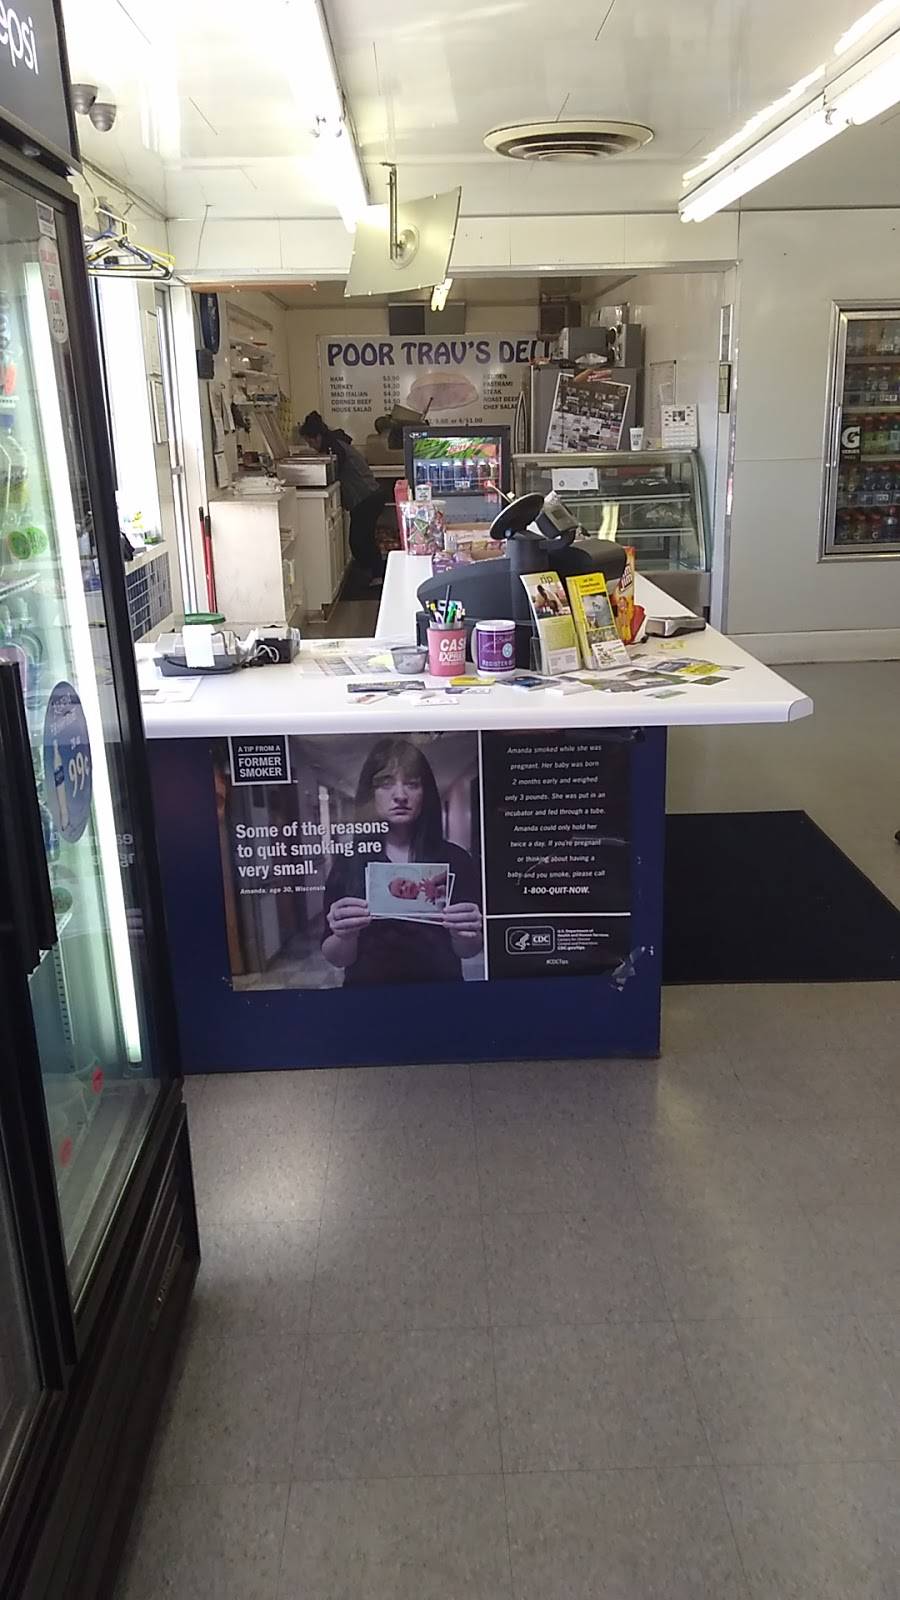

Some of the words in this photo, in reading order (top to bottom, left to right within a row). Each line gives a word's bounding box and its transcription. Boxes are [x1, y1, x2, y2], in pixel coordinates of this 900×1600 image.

[327, 342, 395, 367] POOR
[400, 341, 491, 365] TRAV'S
[841, 426, 861, 448] G
[238, 756, 282, 767] FORMER
[510, 762, 539, 770] pregnant.
[554, 761, 569, 769] baby
[239, 766, 282, 778] SMOKER
[572, 776, 598, 784] weighed
[525, 793, 549, 801] pounds.
[559, 808, 583, 816] through
[236, 823, 278, 839] Some
[283, 821, 298, 837] of
[302, 821, 326, 836] the
[331, 821, 389, 836] reasons
[574, 839, 601, 847] pregnant
[237, 844, 253, 858] to
[257, 841, 287, 859] quit
[291, 840, 354, 857] smoking
[358, 841, 382, 853] are
[238, 864, 269, 879] very
[273, 860, 318, 876] small.
[507, 871, 521, 879] baby
[523, 886, 590, 895] 1-800-QUIT-NOW.
[533, 935, 549, 943] CDC
